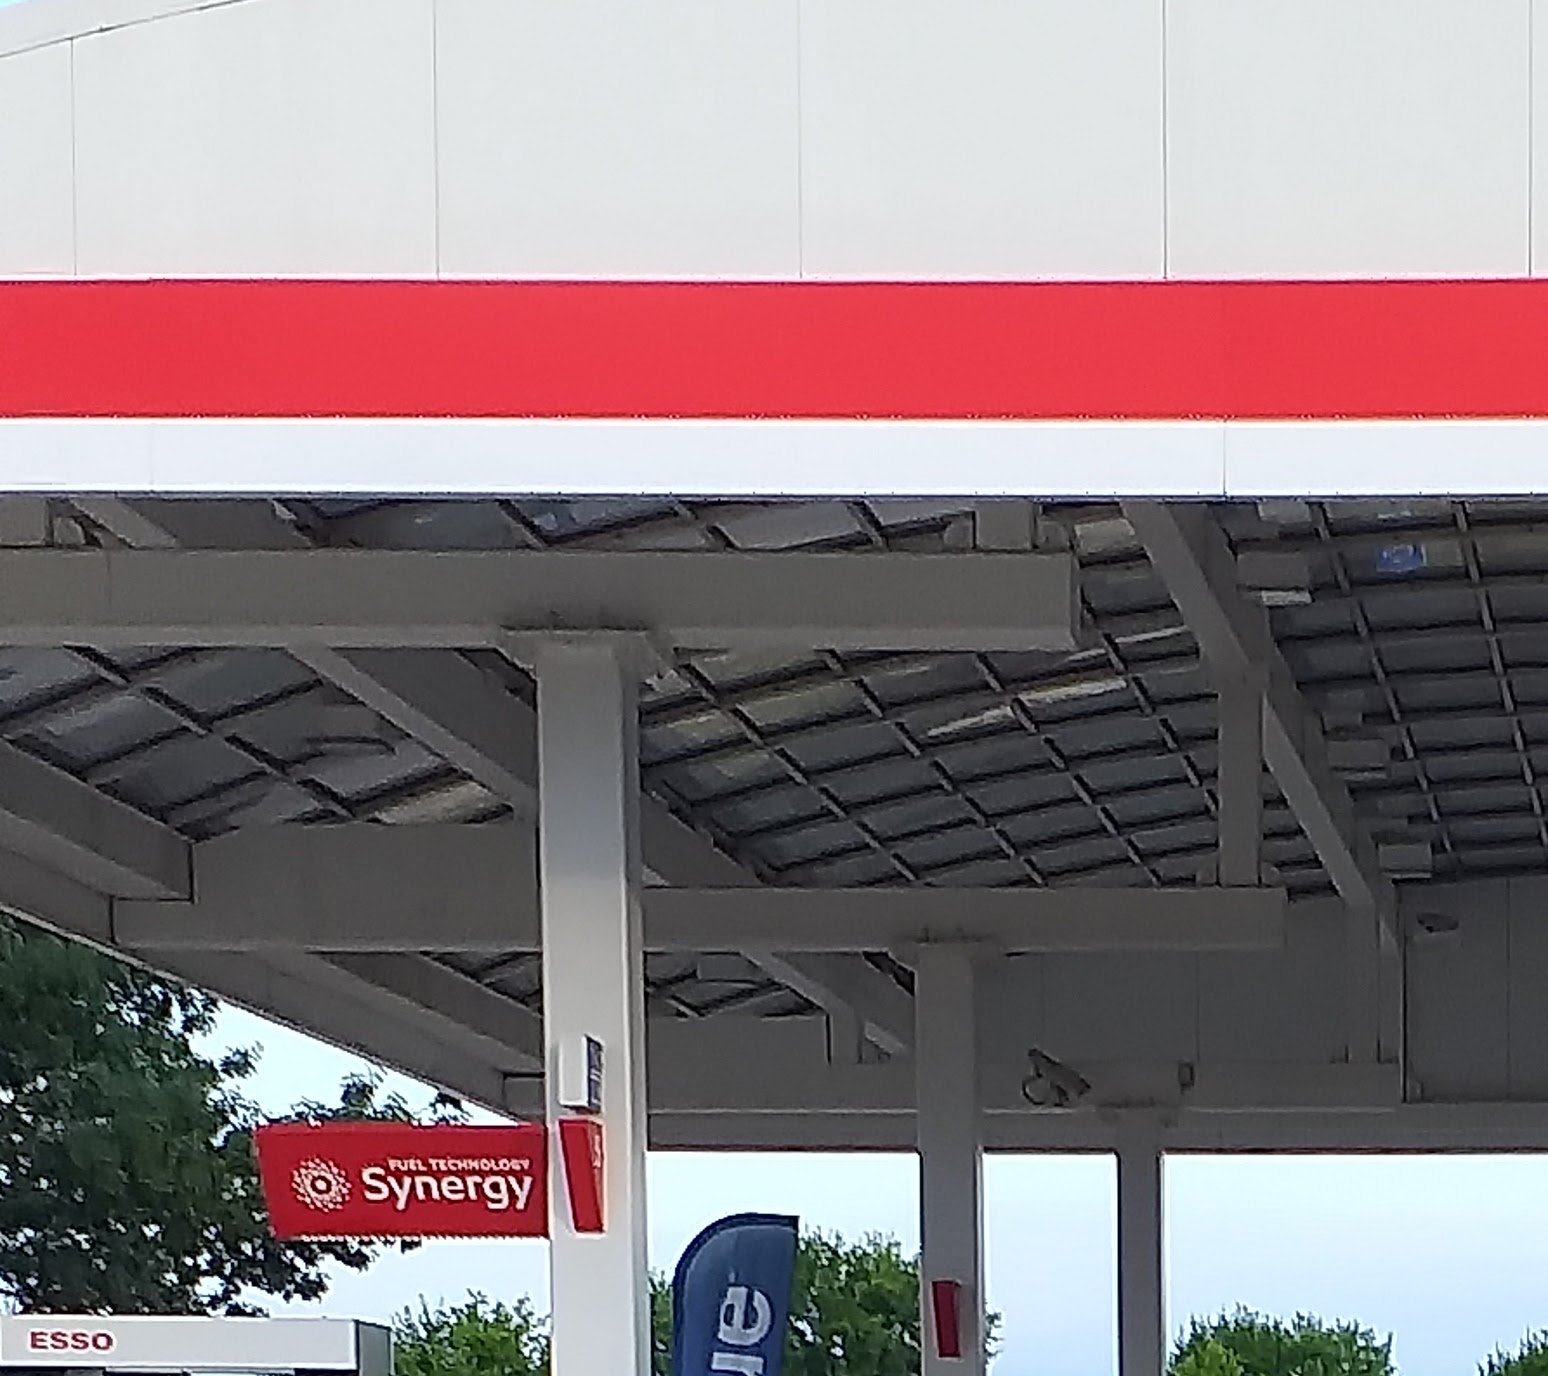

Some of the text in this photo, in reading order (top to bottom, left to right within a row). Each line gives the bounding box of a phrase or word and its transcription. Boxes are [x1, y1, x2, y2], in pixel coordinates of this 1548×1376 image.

[388, 1157, 532, 1172] FUEL TECHNOLOGY
[360, 1166, 535, 1212] Synergy
[29, 1331, 114, 1351] ESSO
